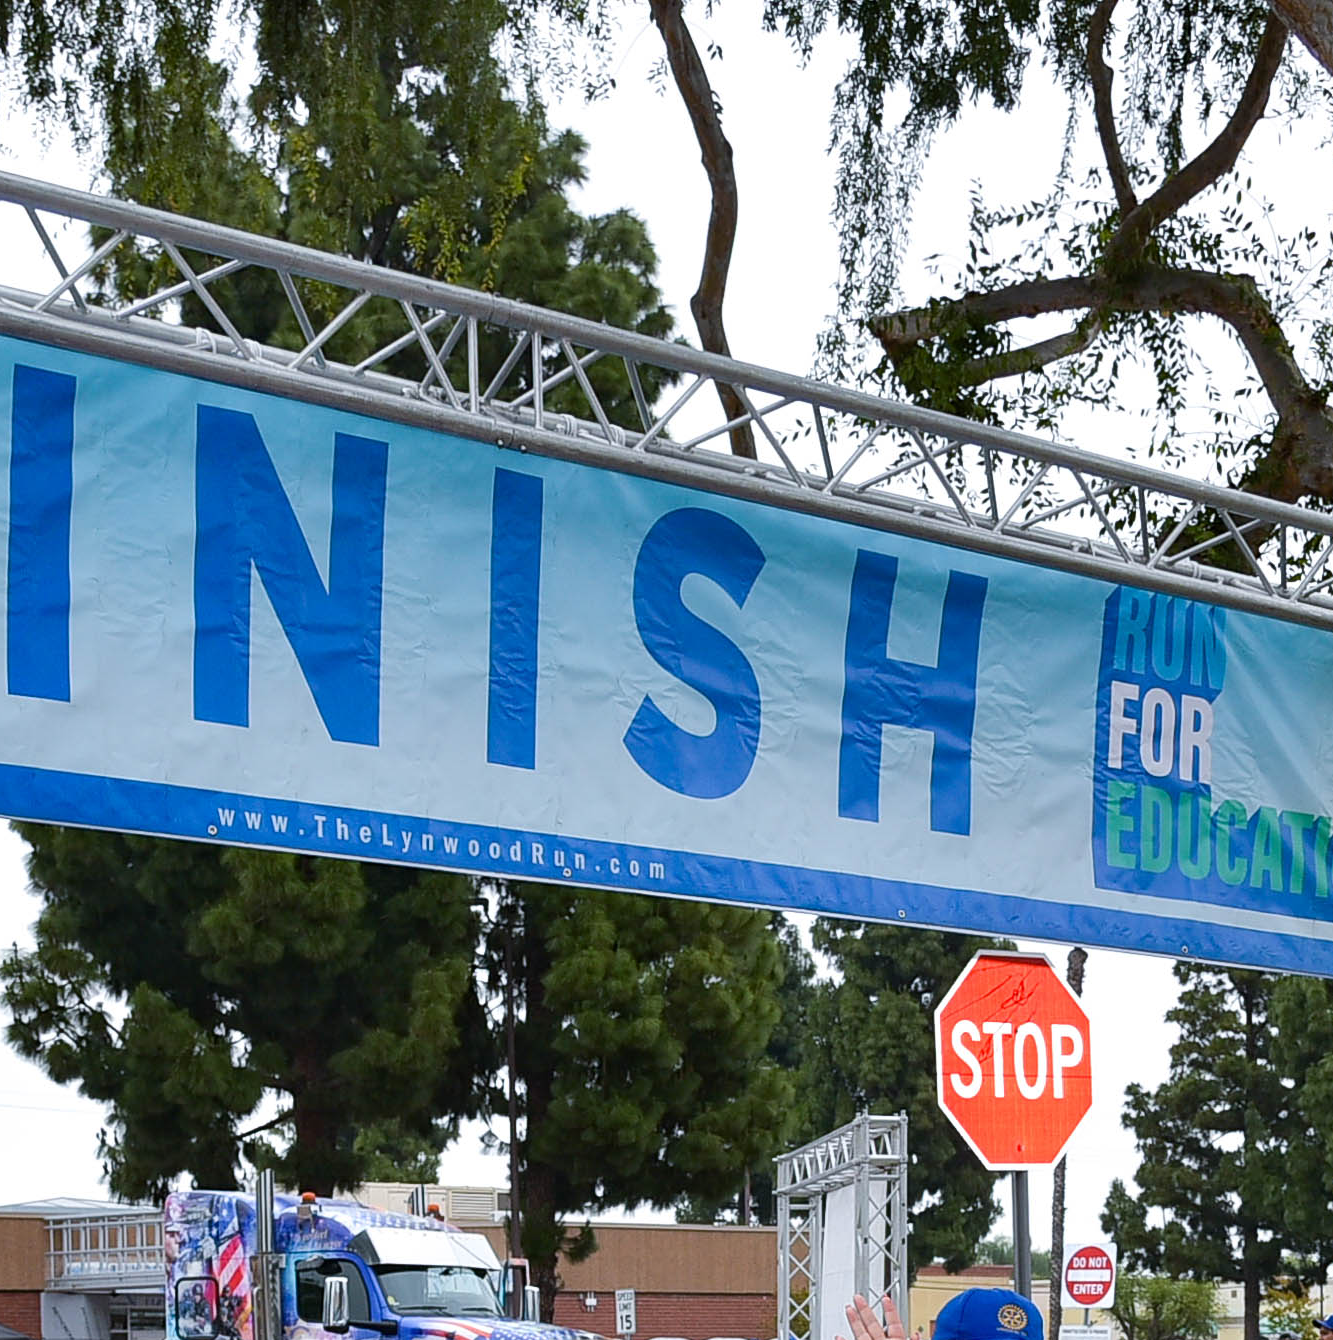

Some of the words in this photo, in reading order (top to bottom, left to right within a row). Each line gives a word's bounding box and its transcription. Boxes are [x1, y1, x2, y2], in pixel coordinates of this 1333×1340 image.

[1113, 585, 1228, 690] RUN
[1108, 680, 1214, 785] FOR
[217, 806, 666, 880] www.TheLynwoodRun.com
[950, 1019, 1084, 1099] STOP
[1072, 1256, 1086, 1268] DO
[1088, 1256, 1107, 1268] NOT
[1072, 1283, 1104, 1295] ENTER
[619, 1315, 633, 1330] 15
